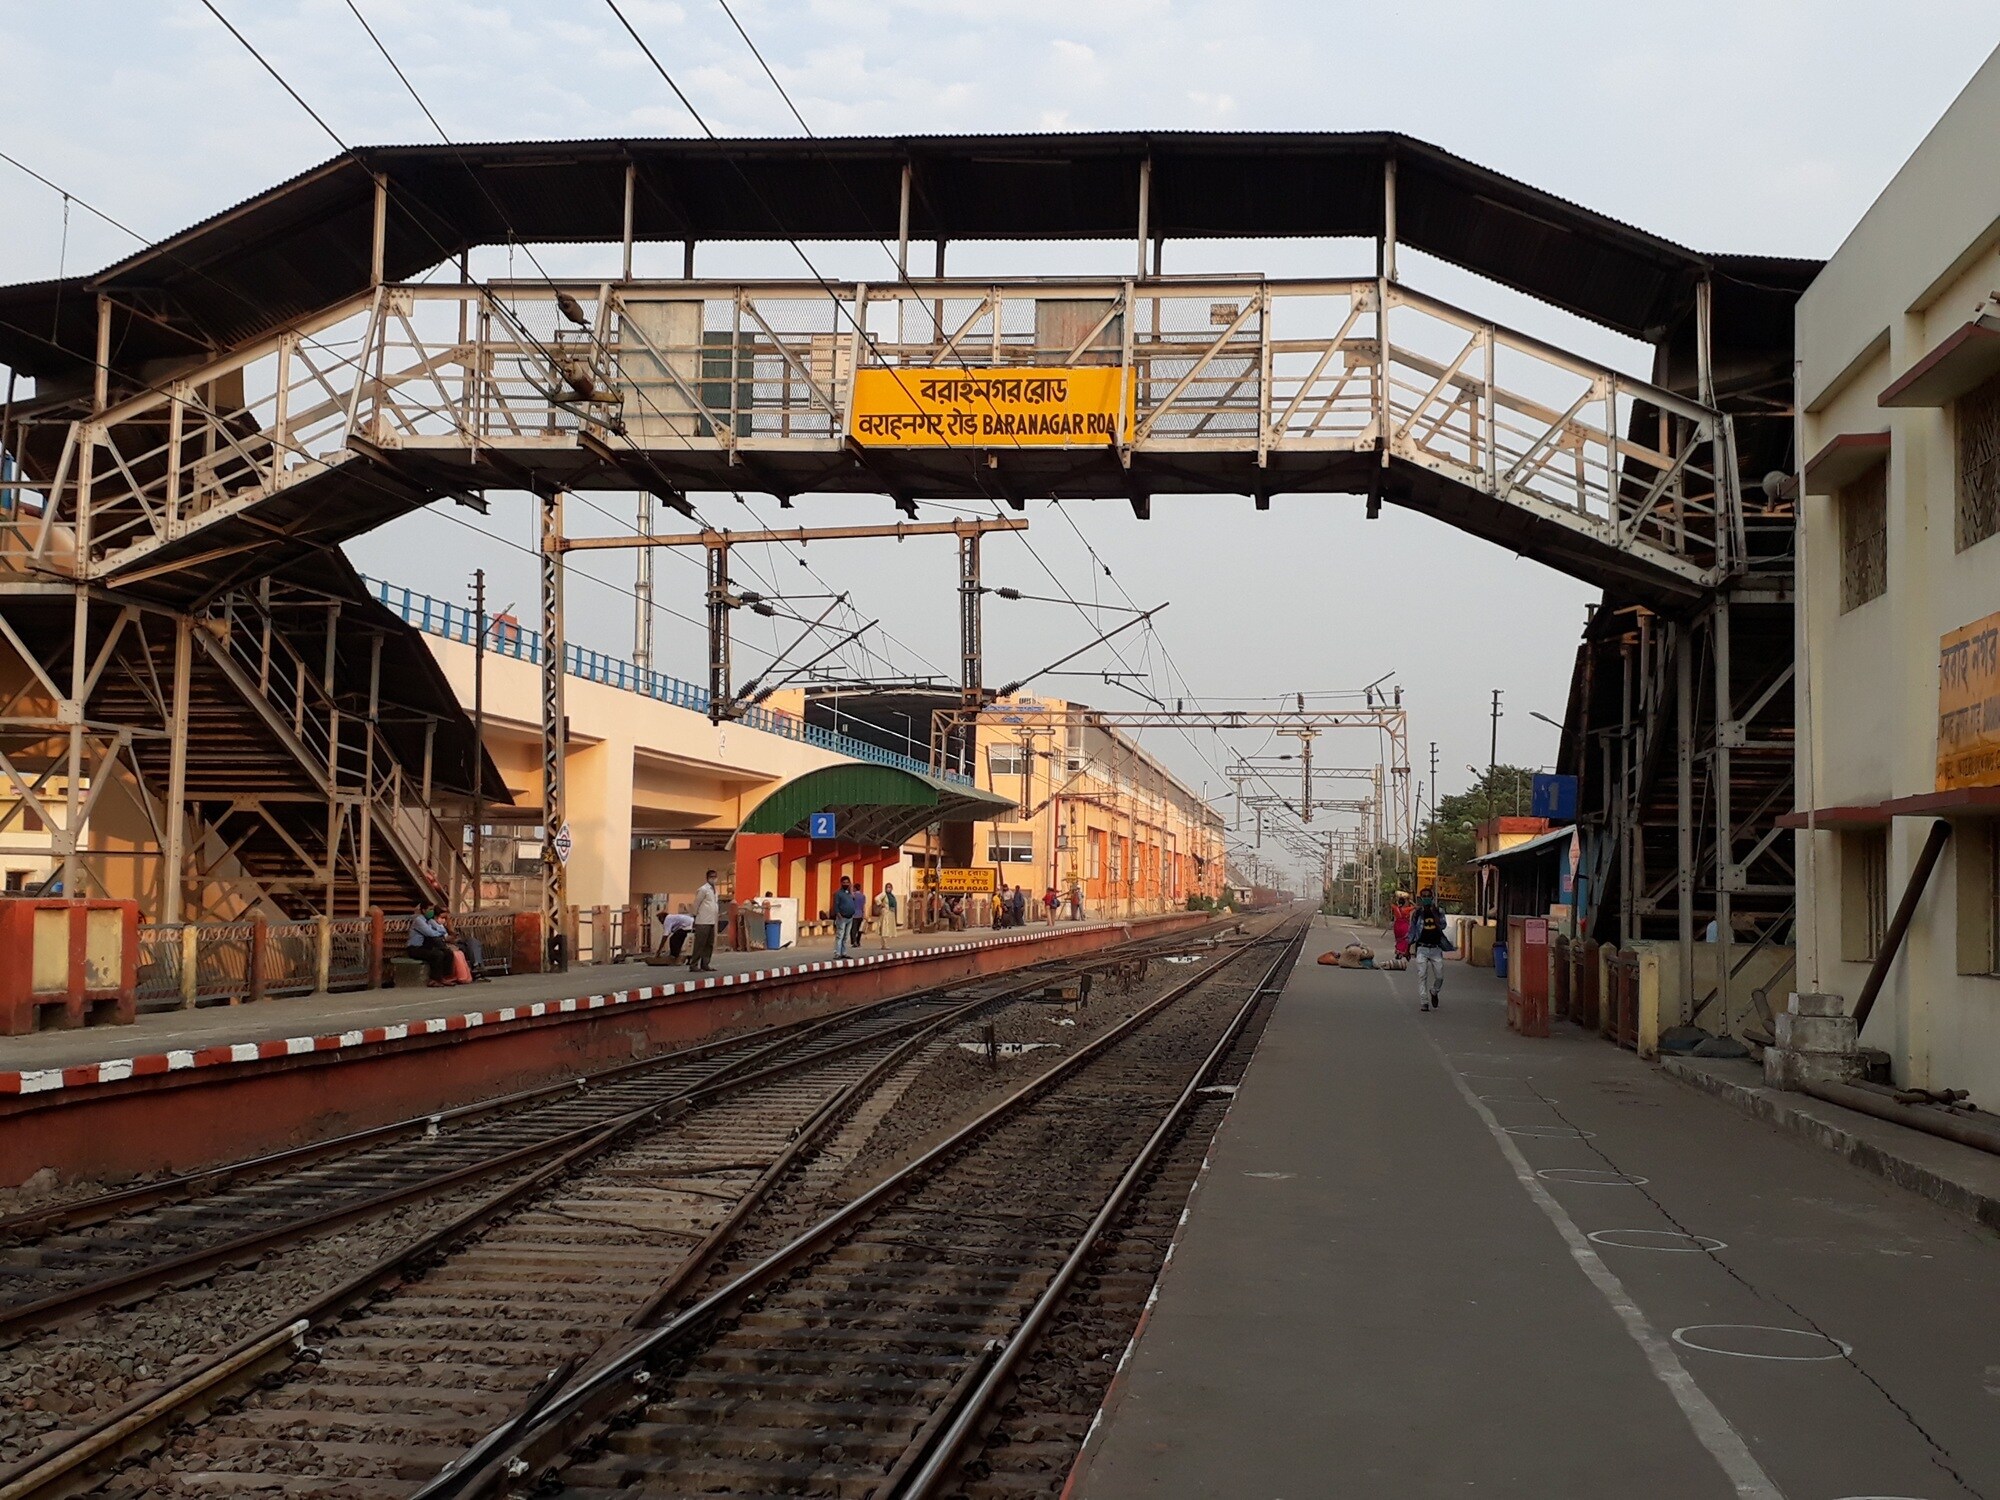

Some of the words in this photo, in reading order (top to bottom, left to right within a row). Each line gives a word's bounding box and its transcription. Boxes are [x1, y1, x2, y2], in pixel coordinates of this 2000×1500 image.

[1024, 378, 1068, 405] রোড
[947, 407, 978, 437] रोड
[983, 413, 1084, 435] BARANAGAR
[817, 817, 828, 834] 2
